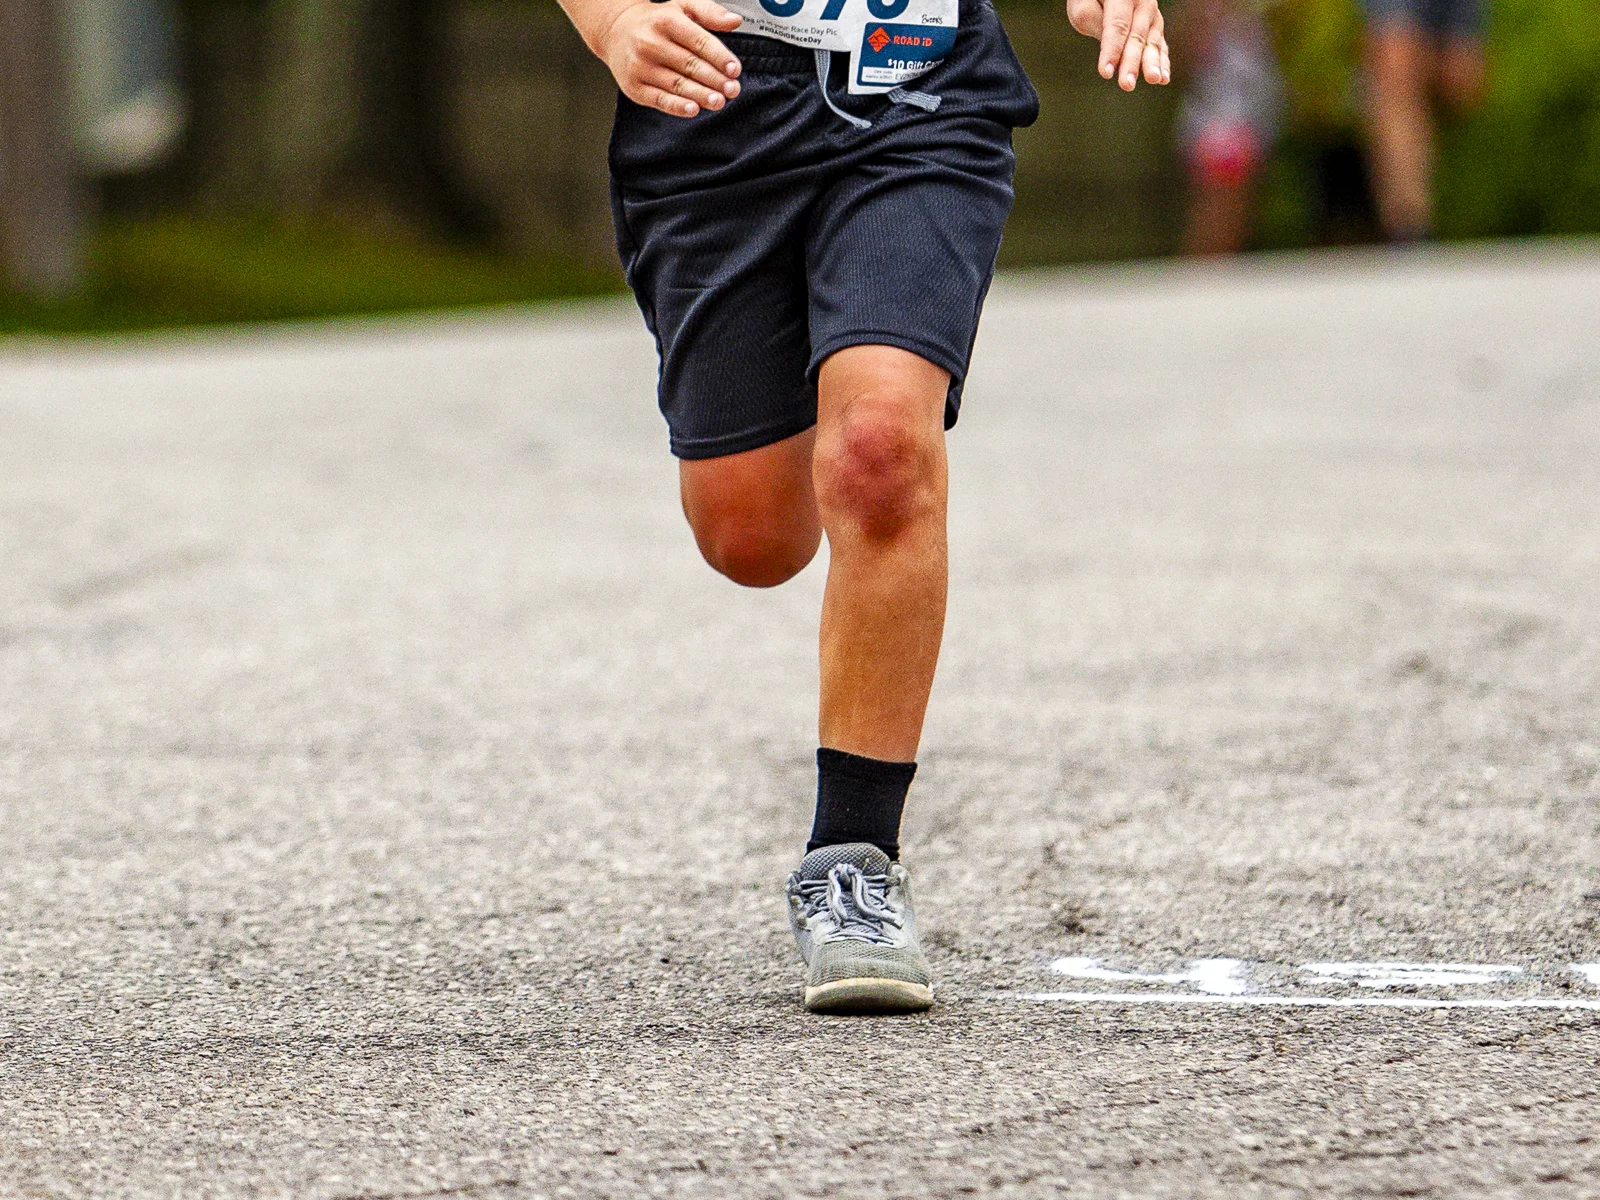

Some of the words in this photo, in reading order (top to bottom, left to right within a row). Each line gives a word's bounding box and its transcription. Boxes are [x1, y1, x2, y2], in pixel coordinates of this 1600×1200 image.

[791, 25, 808, 34] Race
[810, 26, 824, 36] Day
[826, 28, 838, 36] Pic
[893, 35, 920, 47] ROAD
[888, 58, 905, 70] $10
[906, 60, 924, 71] Gift
